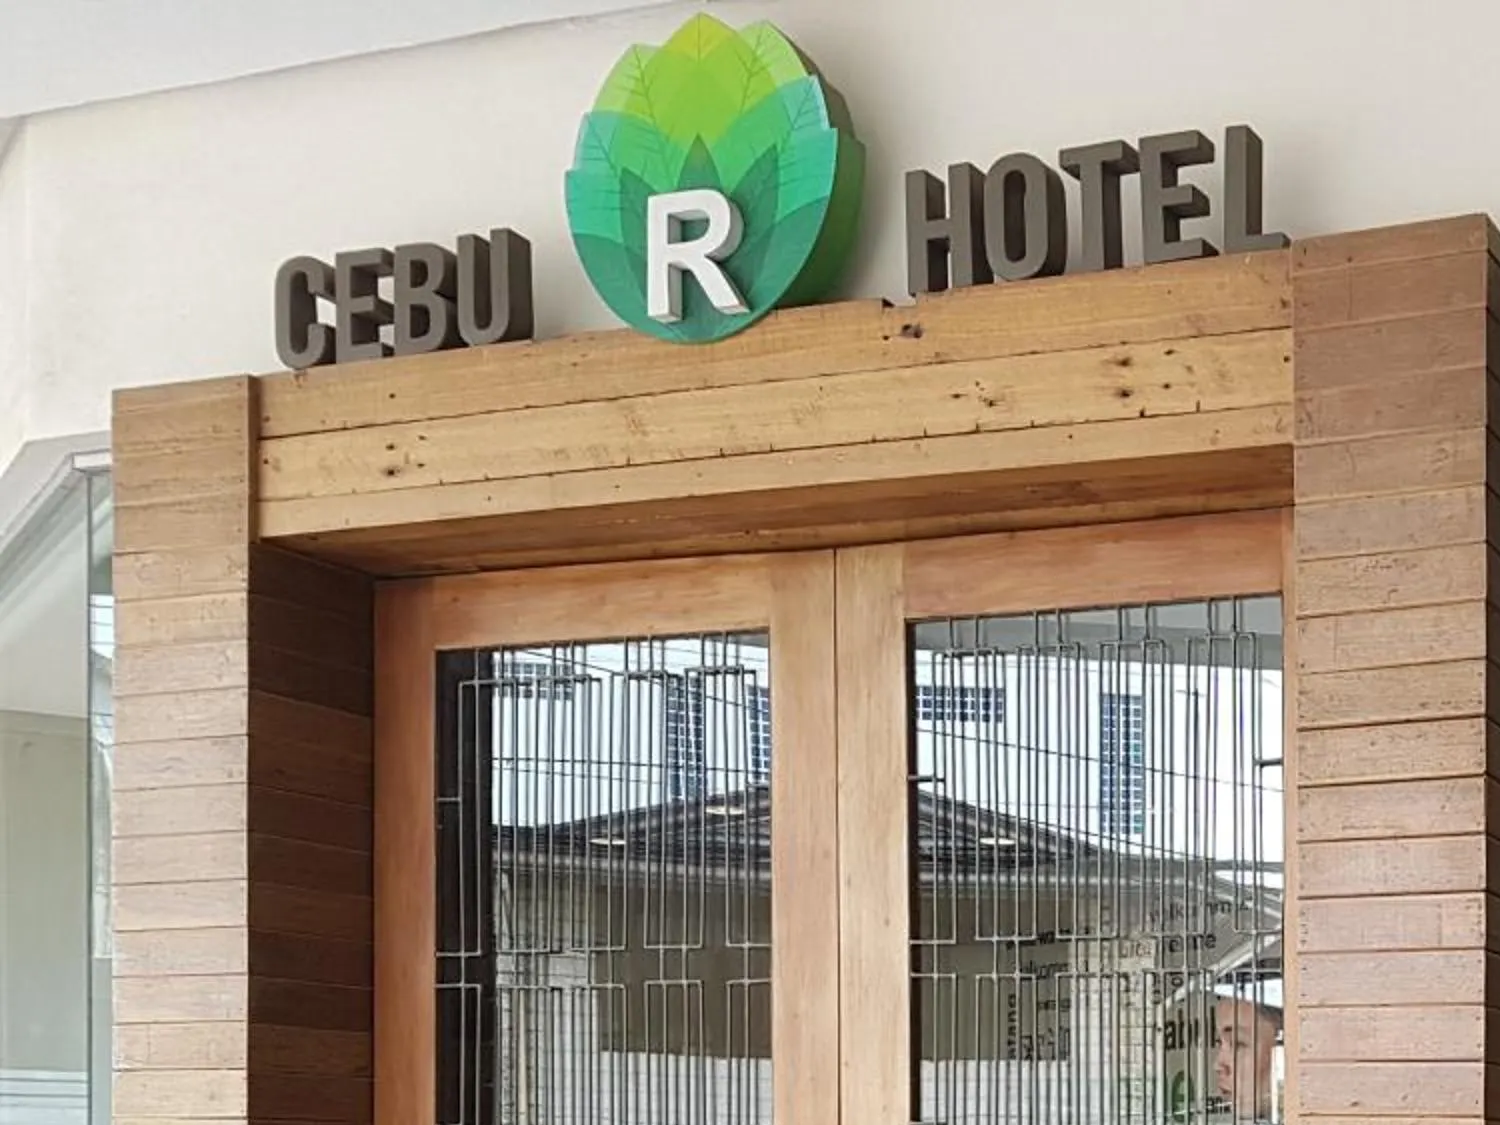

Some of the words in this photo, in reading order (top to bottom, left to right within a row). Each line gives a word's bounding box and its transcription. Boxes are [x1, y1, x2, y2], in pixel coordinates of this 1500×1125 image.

[275, 228, 533, 370] CEBU
[647, 188, 749, 324] R
[905, 125, 1291, 297] HOTEL
